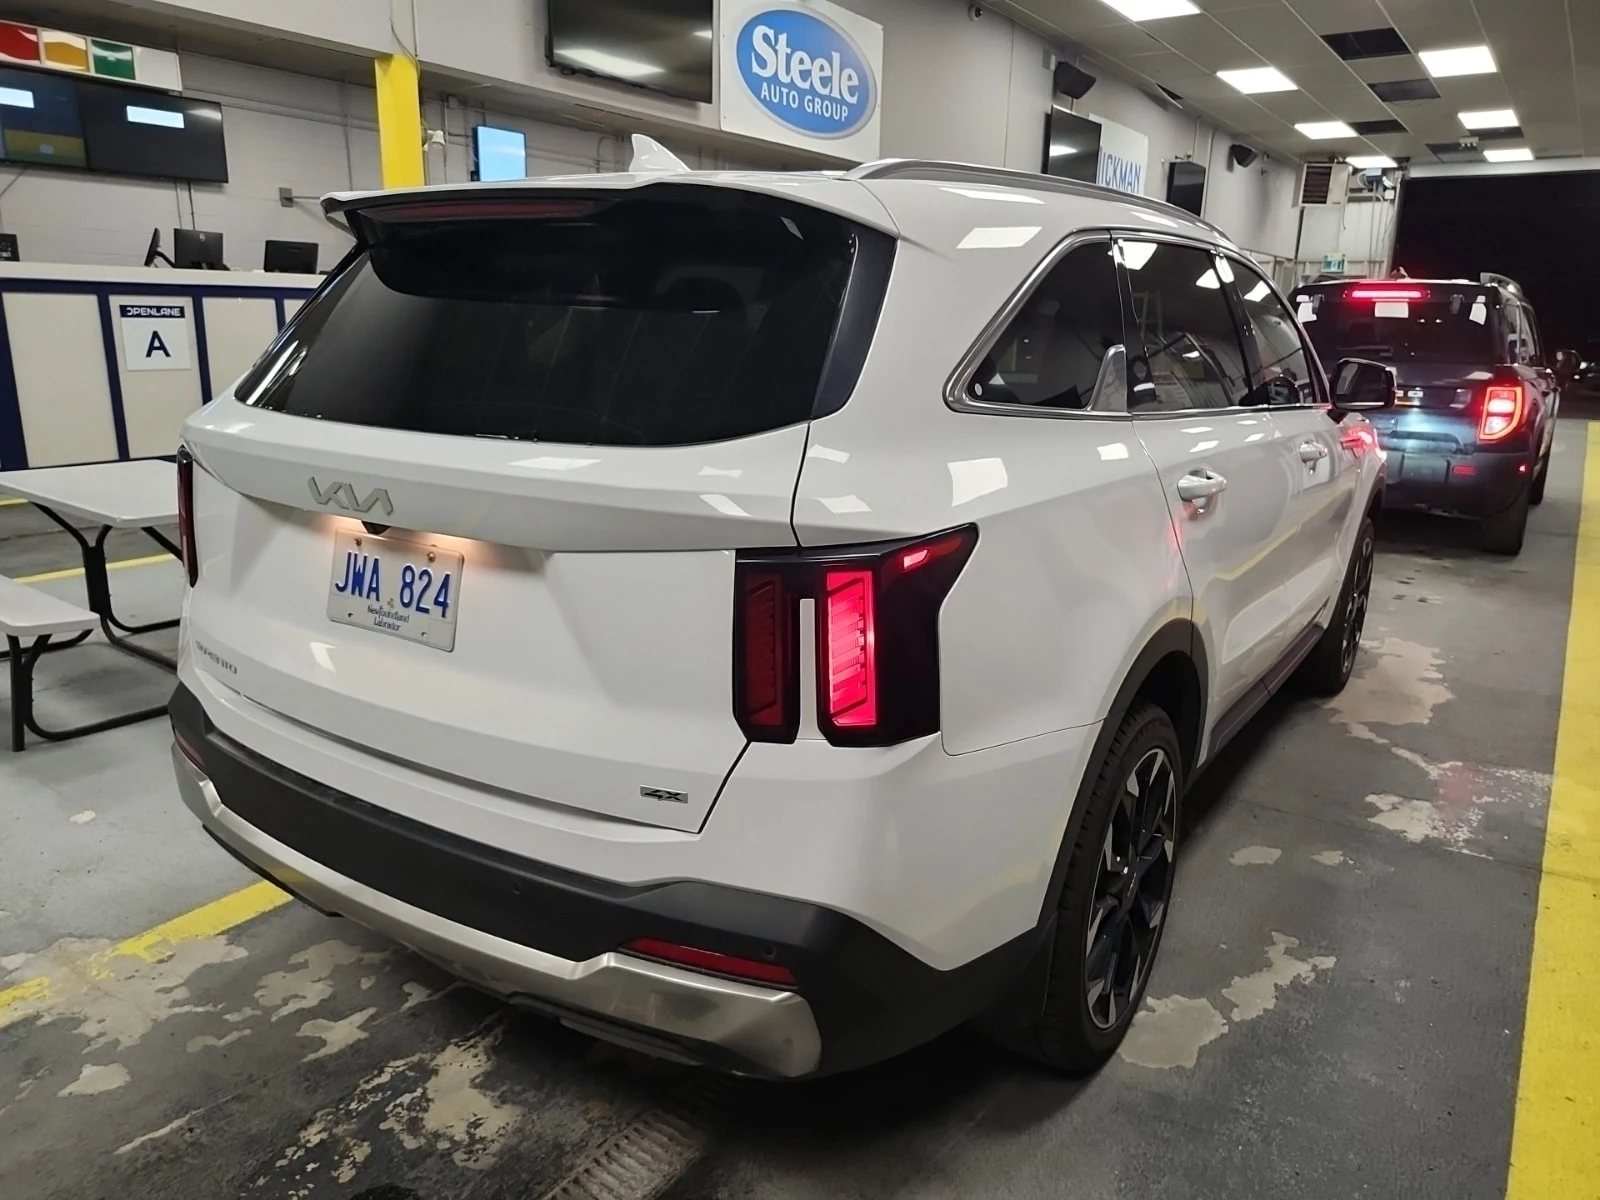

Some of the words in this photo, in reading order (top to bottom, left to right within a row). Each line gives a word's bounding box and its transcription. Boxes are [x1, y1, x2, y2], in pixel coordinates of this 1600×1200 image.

[751, 25, 859, 104] Steele
[761, 82, 799, 108] AUTO
[804, 95, 849, 122] GROUP
[126, 307, 181, 317] OPENLANE
[145, 330, 171, 358] A
[335, 551, 381, 602] JWA
[399, 564, 451, 618] 824
[367, 604, 410, 623] Newfoundland
[373, 617, 401, 632] Labrador
